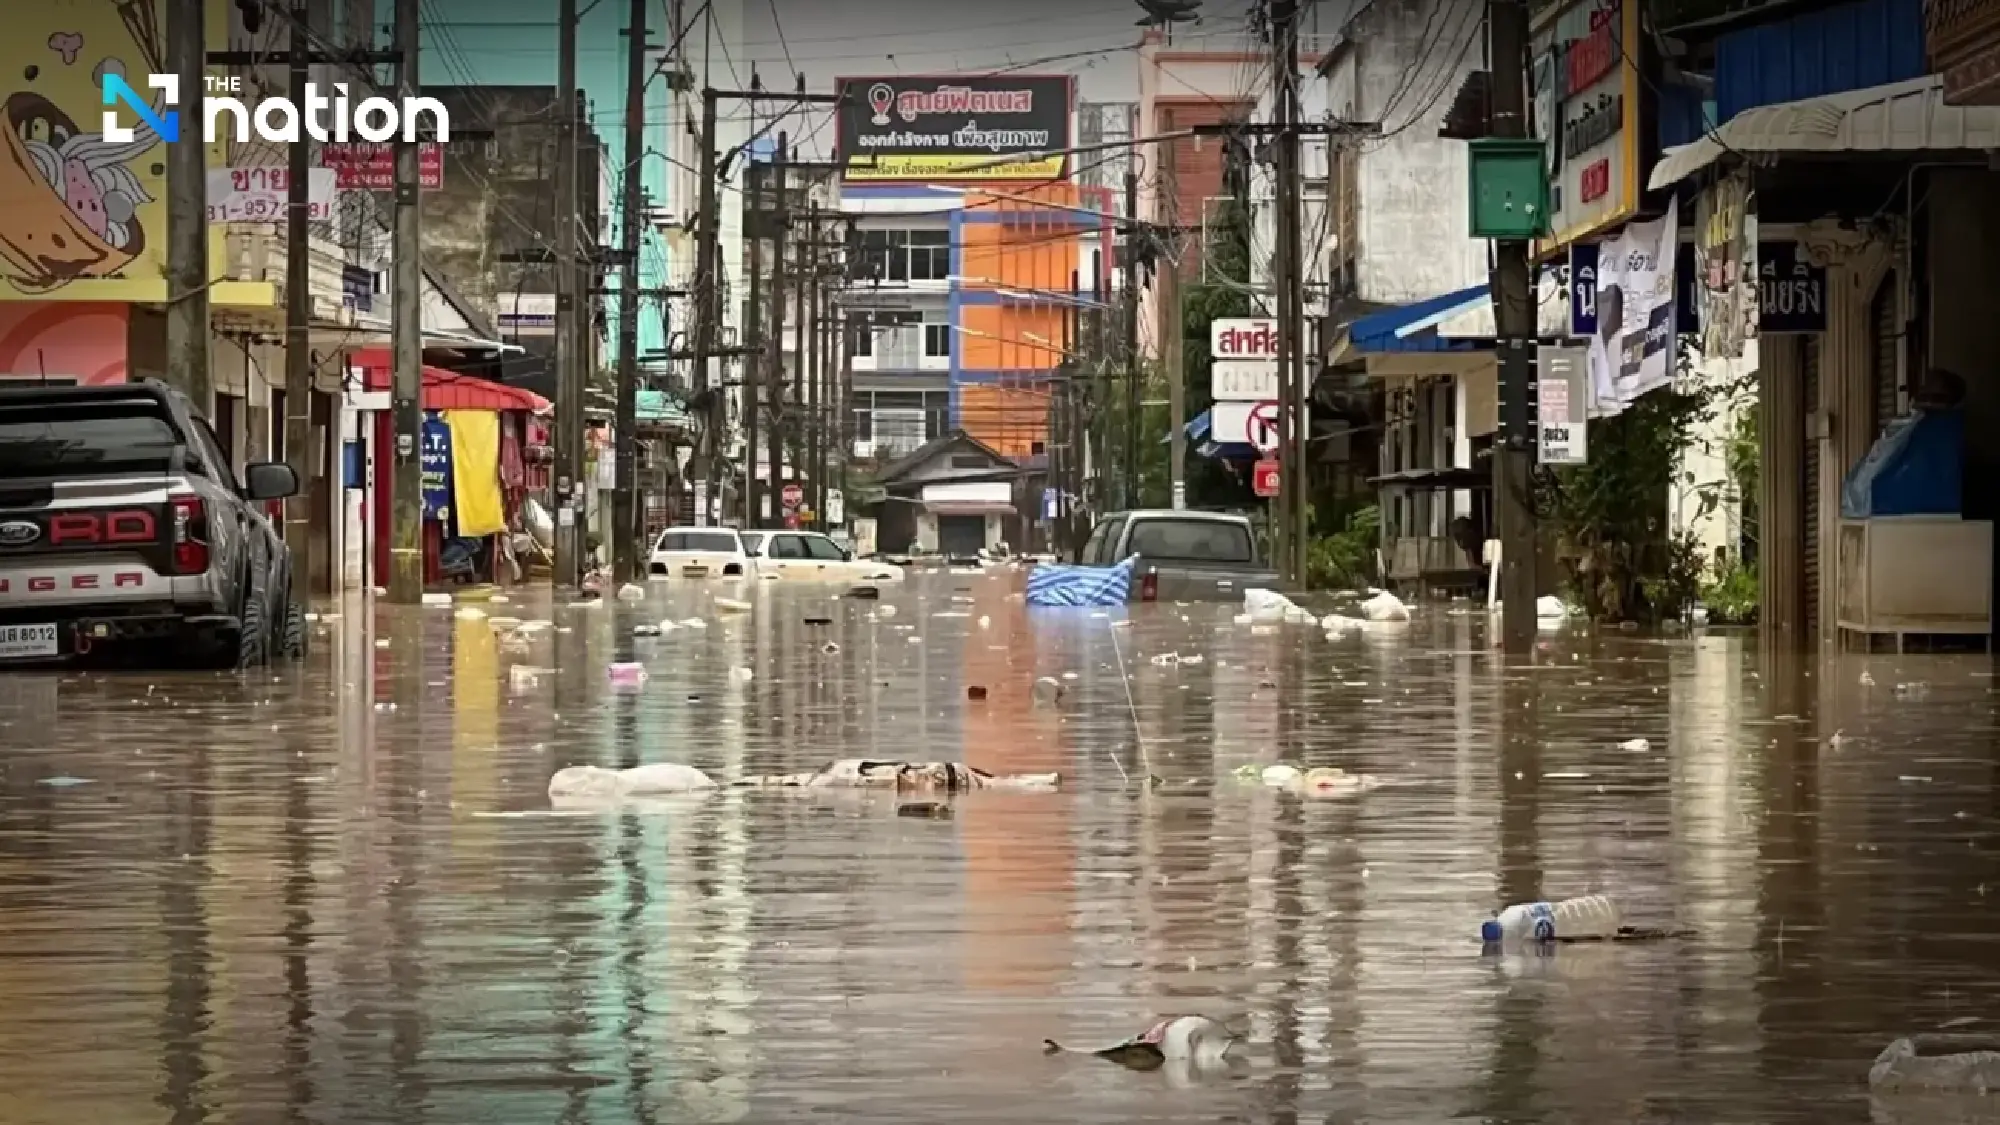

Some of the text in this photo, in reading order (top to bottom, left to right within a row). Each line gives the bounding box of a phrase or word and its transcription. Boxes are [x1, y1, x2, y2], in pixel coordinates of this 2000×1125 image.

[858, 119, 1049, 152] ออกกำลังกาย เพื่อสุขภาพ
[20, 626, 55, 641] 8012
